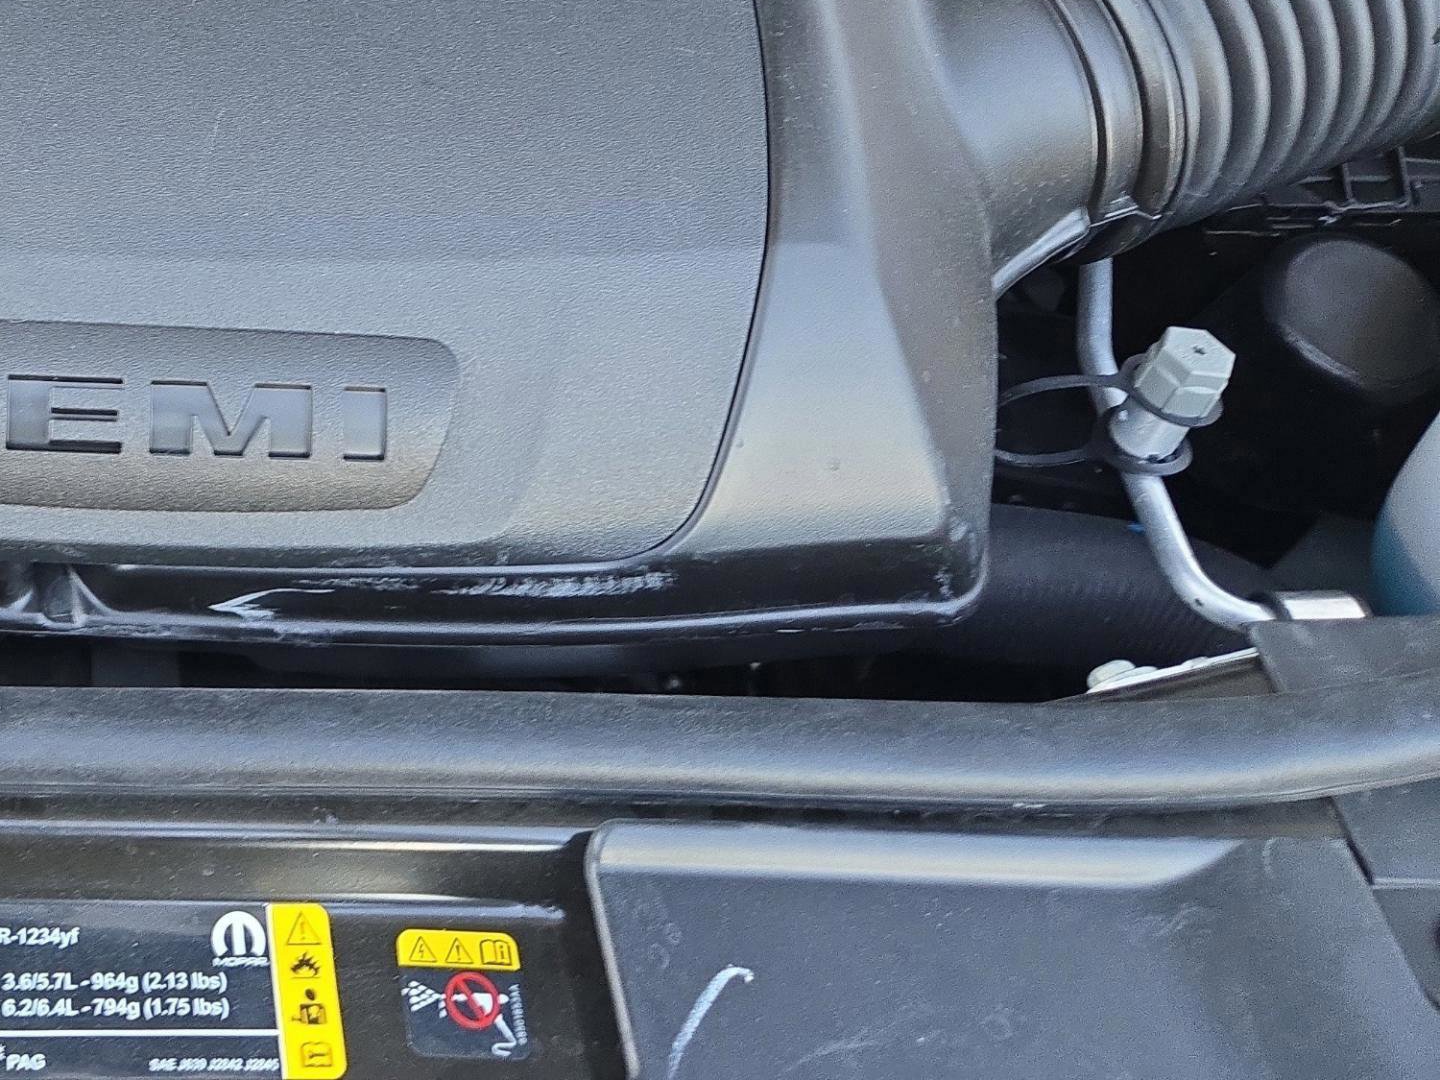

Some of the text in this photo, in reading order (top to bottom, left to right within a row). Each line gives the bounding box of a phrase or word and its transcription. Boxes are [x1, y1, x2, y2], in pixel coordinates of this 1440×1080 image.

[1, 971, 79, 991] 3.6/5.7L
[90, 971, 140, 995] 964g
[141, 971, 188, 995] (2.13
[190, 970, 228, 993] lbs)
[1, 997, 80, 1018] 6.2/6.4L
[91, 997, 141, 1021] 794g
[143, 997, 191, 1021] (1.75
[192, 997, 230, 1020] lbs)
[5, 1053, 46, 1071] PAG
[148, 1057, 178, 1071] SAE
